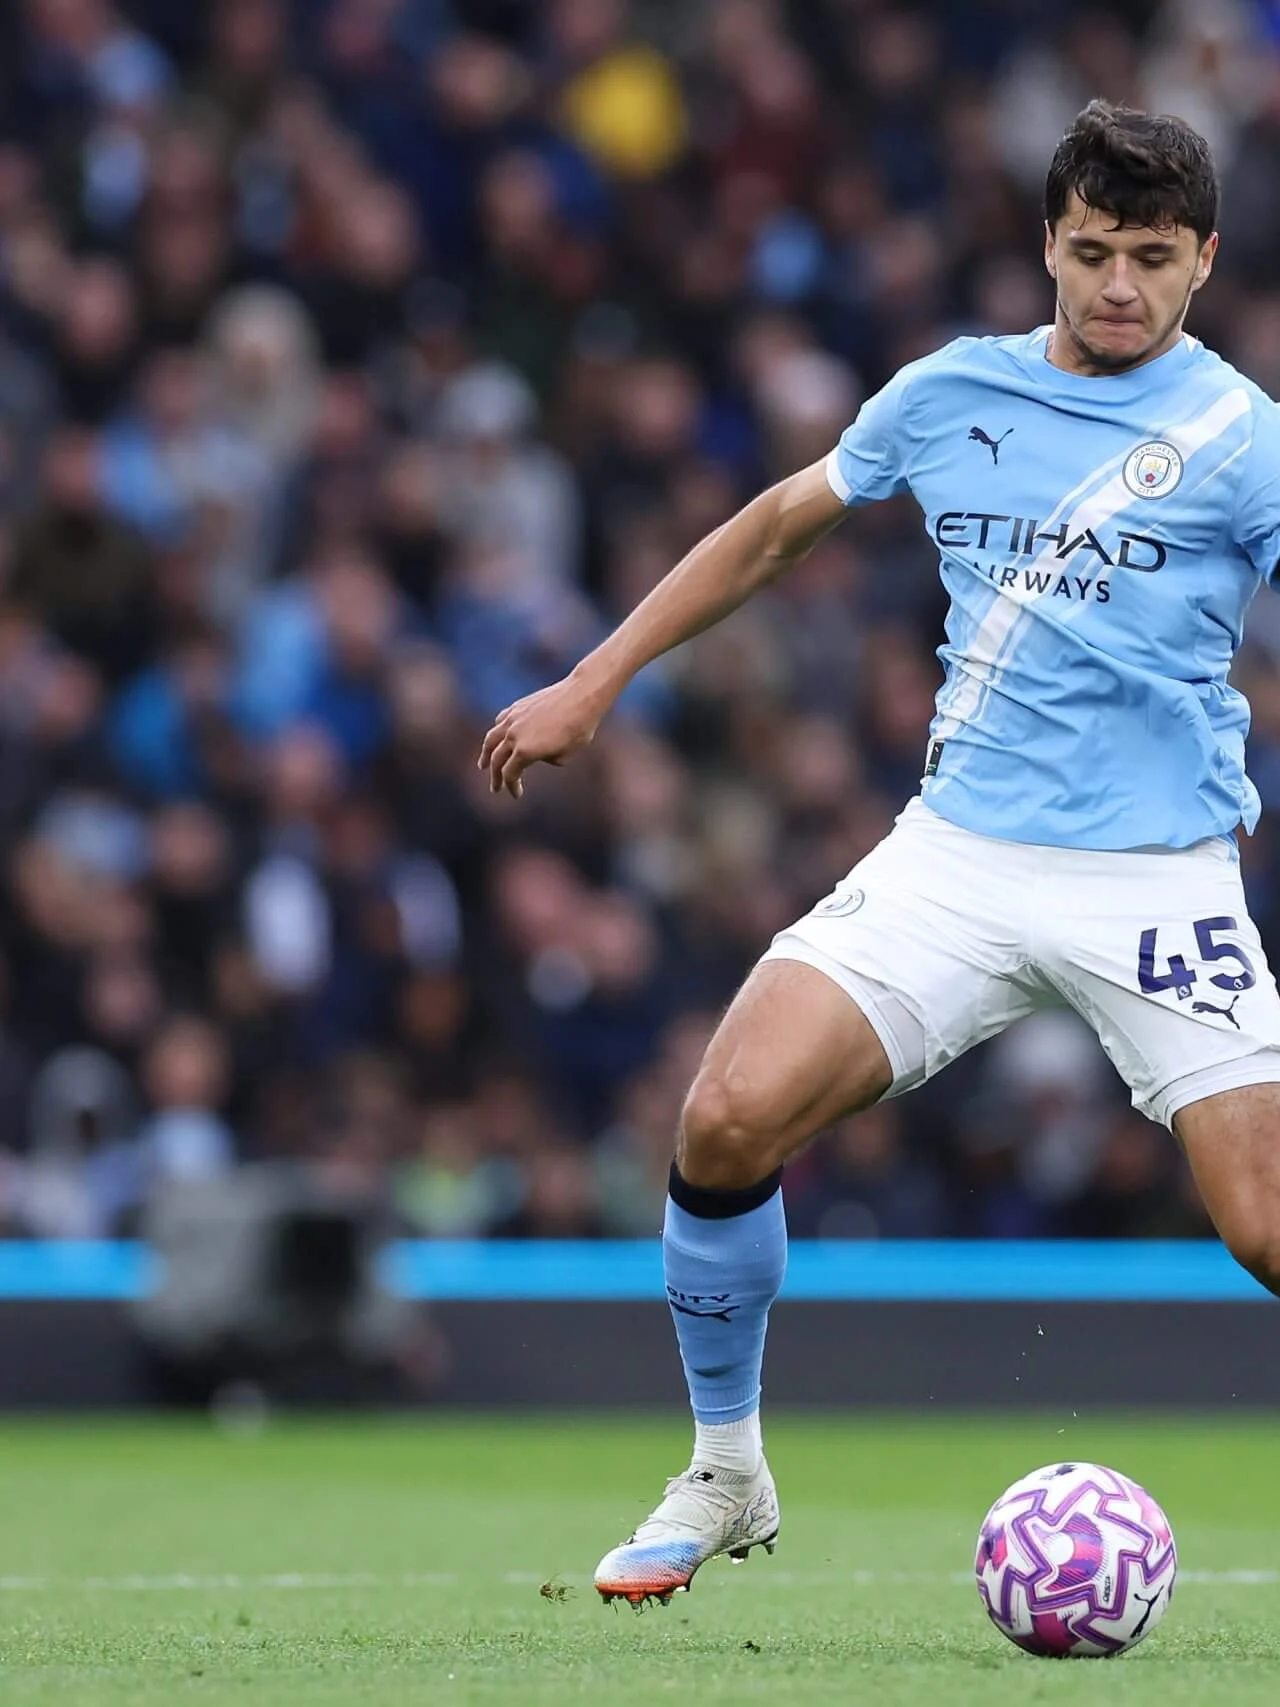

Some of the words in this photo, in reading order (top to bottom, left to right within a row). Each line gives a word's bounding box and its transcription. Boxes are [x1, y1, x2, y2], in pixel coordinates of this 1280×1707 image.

[935, 511, 1167, 573] ETIHAD
[1137, 916, 1257, 1001] 45
[666, 1285, 730, 1303] CITY
